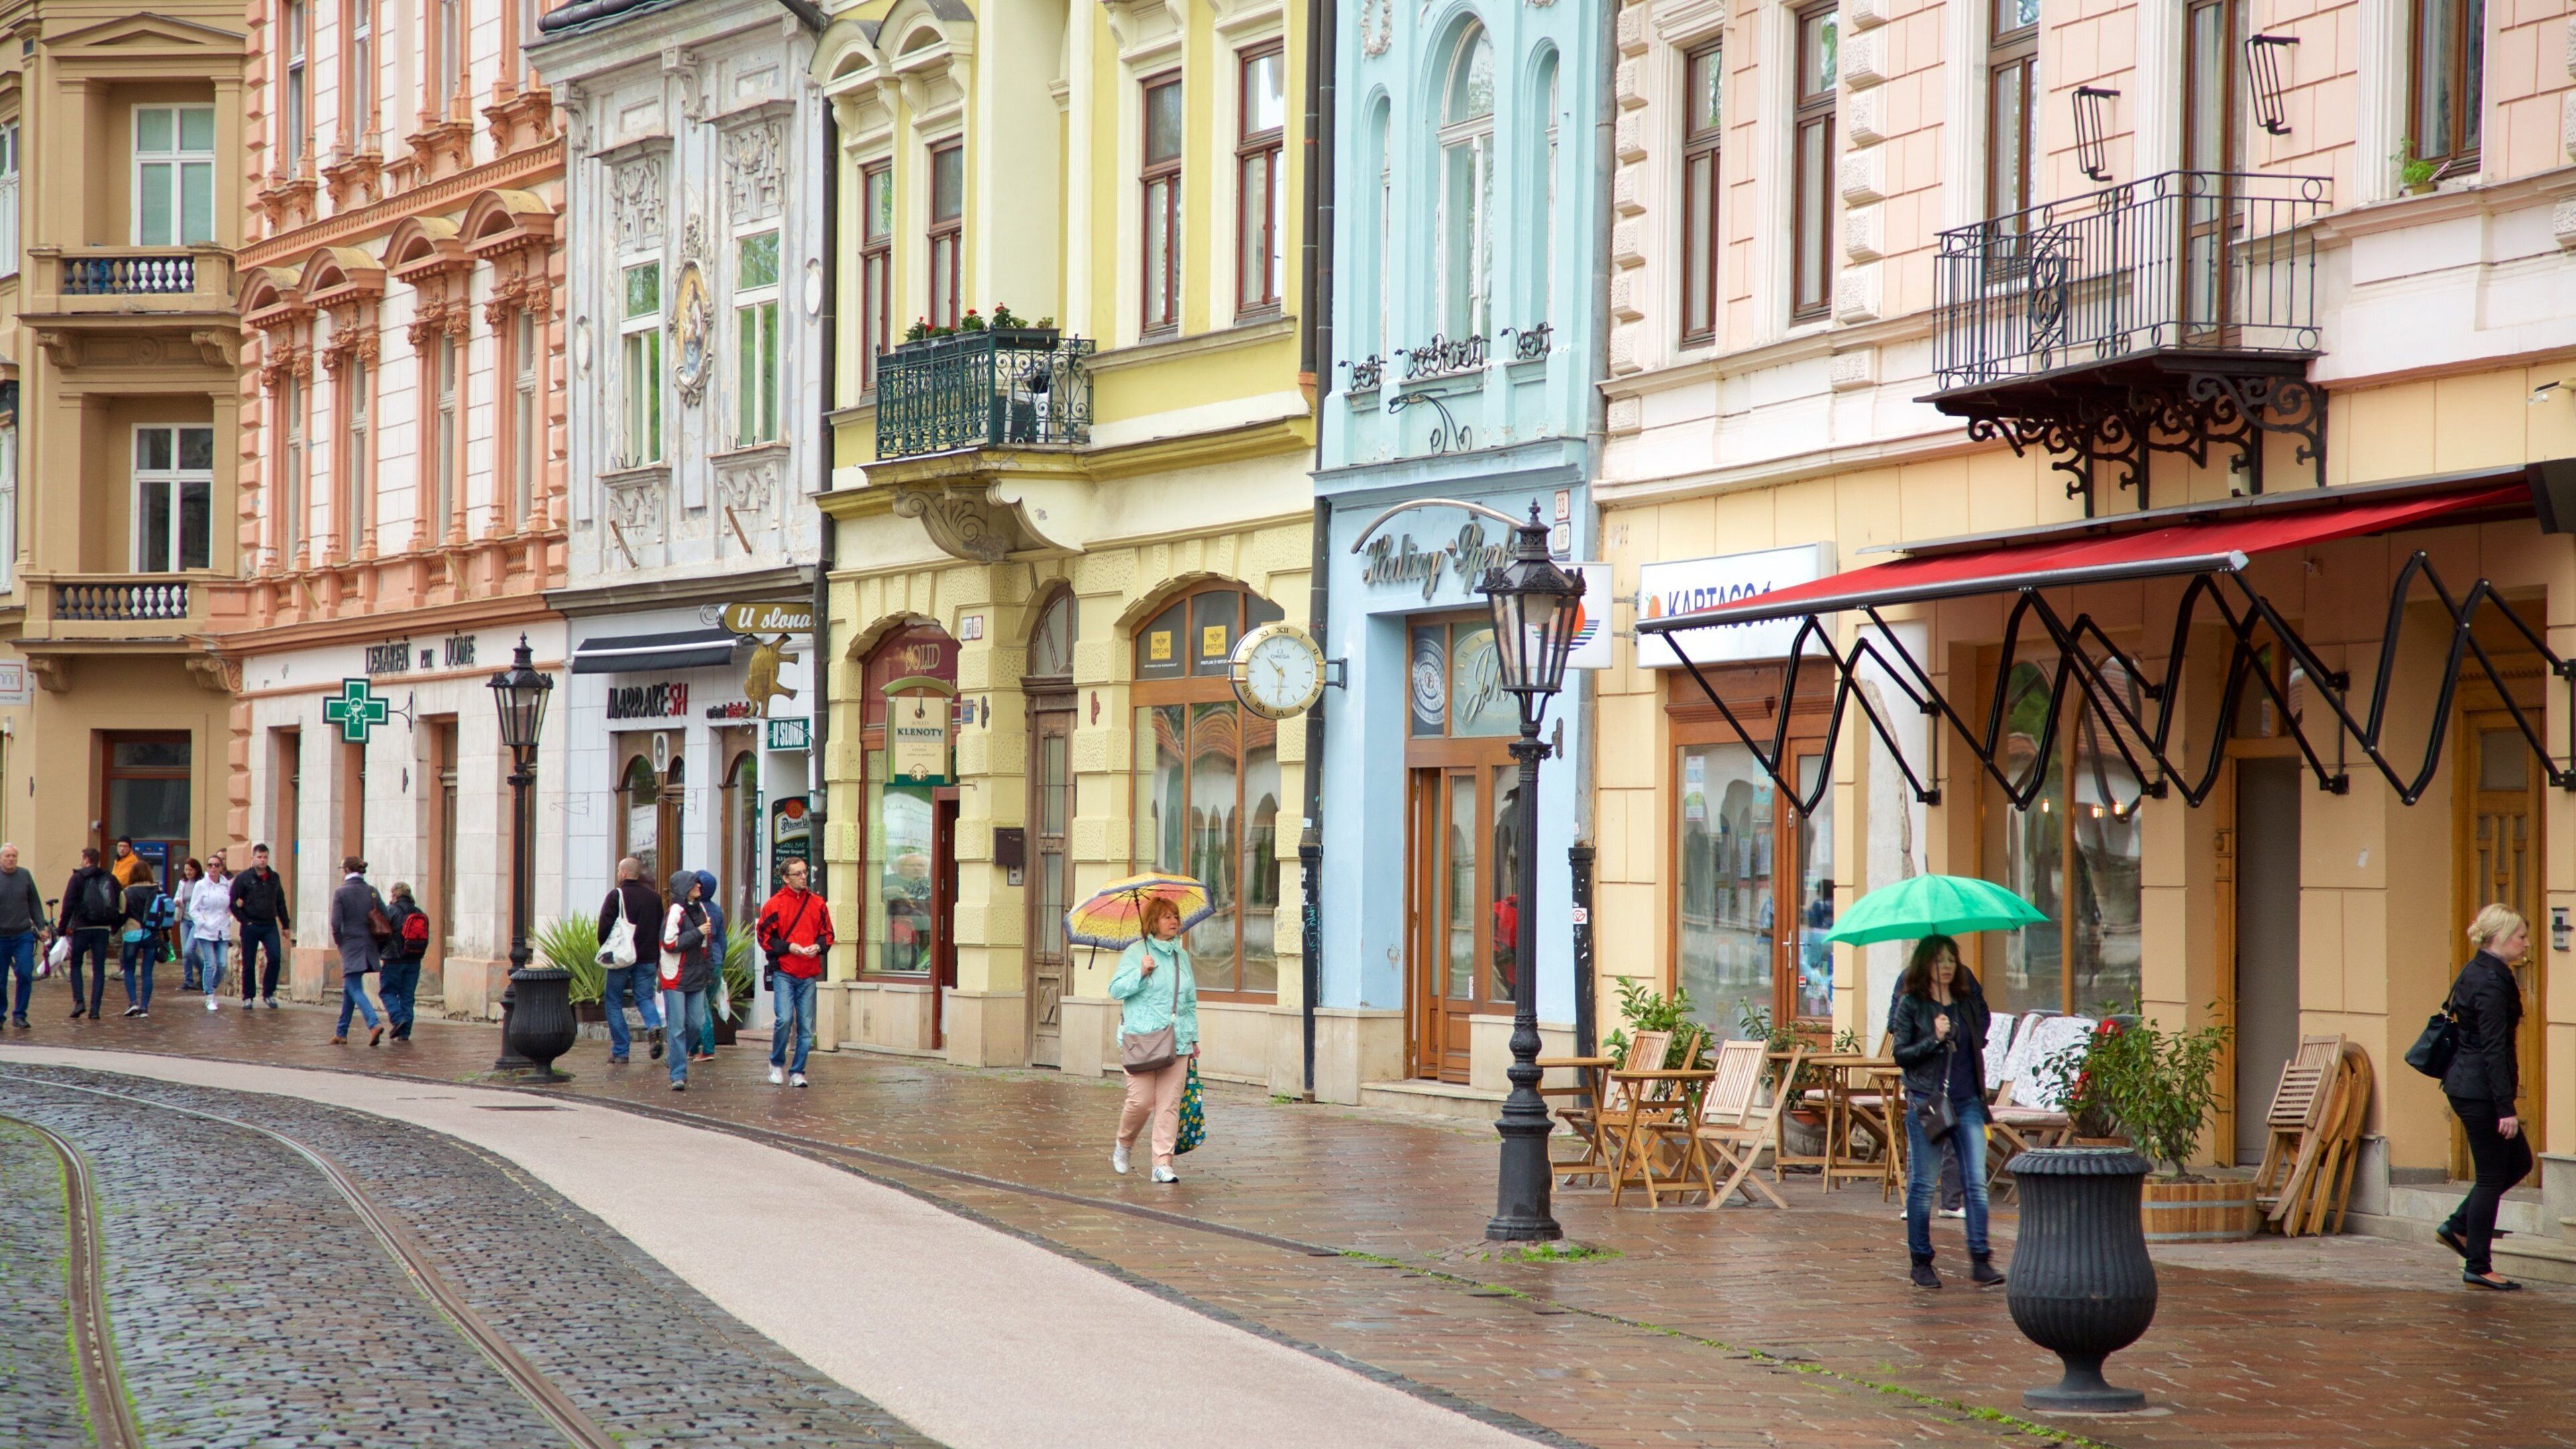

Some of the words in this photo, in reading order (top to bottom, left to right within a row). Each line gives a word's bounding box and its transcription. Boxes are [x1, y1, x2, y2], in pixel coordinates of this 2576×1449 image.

[1558, 497, 1565, 513] 33
[1362, 534, 1446, 600] Hodiny
[1453, 505, 1519, 595] Šperk
[738, 606, 755, 629] U
[759, 606, 812, 629] slona
[1258, 631, 1269, 639] XI
[444, 629, 477, 667] DÓME
[906, 643, 941, 674] SOLID
[1205, 643, 1224, 651] BREITLING
[606, 682, 688, 719] MARRAKESH
[773, 722, 779, 747] U
[780, 720, 804, 747] SLONA
[897, 727, 943, 737] KLENOTY
[781, 817, 803, 835] Pilsner
